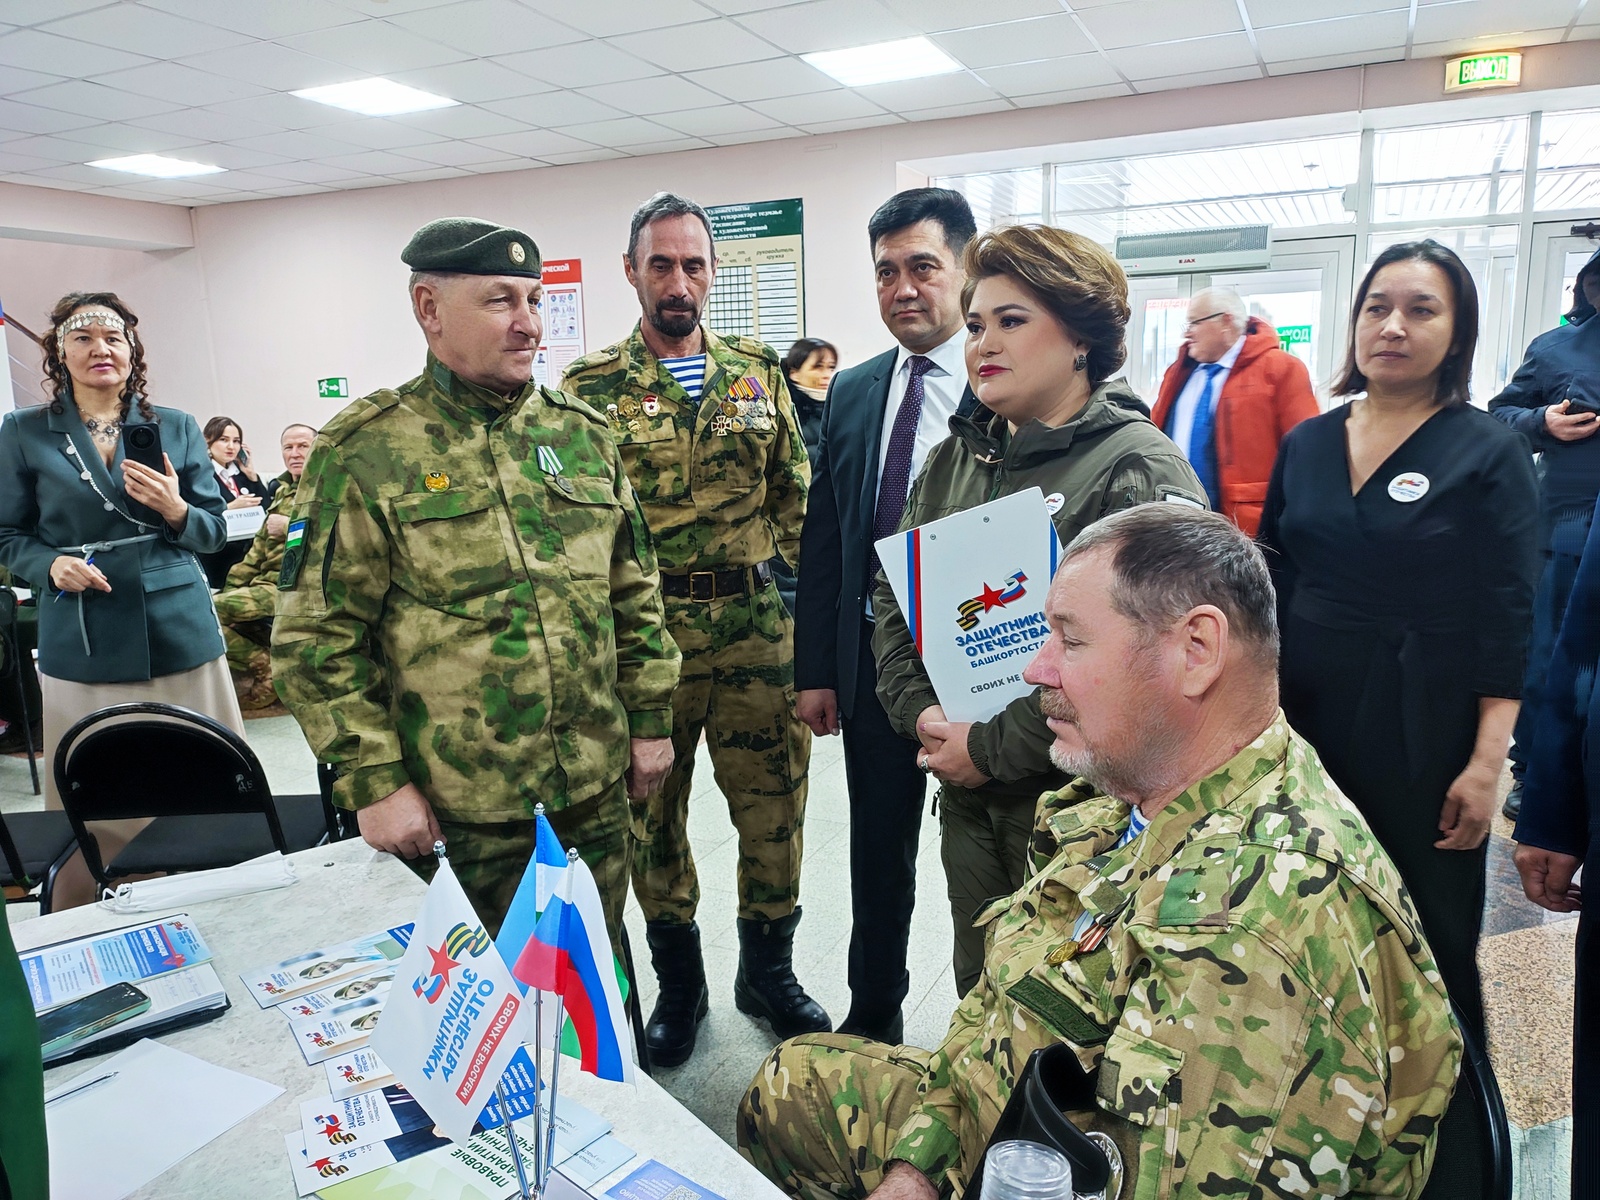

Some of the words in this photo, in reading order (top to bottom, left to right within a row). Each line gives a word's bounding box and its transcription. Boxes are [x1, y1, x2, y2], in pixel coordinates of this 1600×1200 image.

[1462, 58, 1506, 82] ВЫХОД
[965, 624, 1051, 658] ОТЕЧЕСТВА
[970, 674, 1005, 694] СВОИХ
[1007, 674, 1021, 684] НЕ
[450, 1148, 510, 1188] ПРАВОВЫЕ
